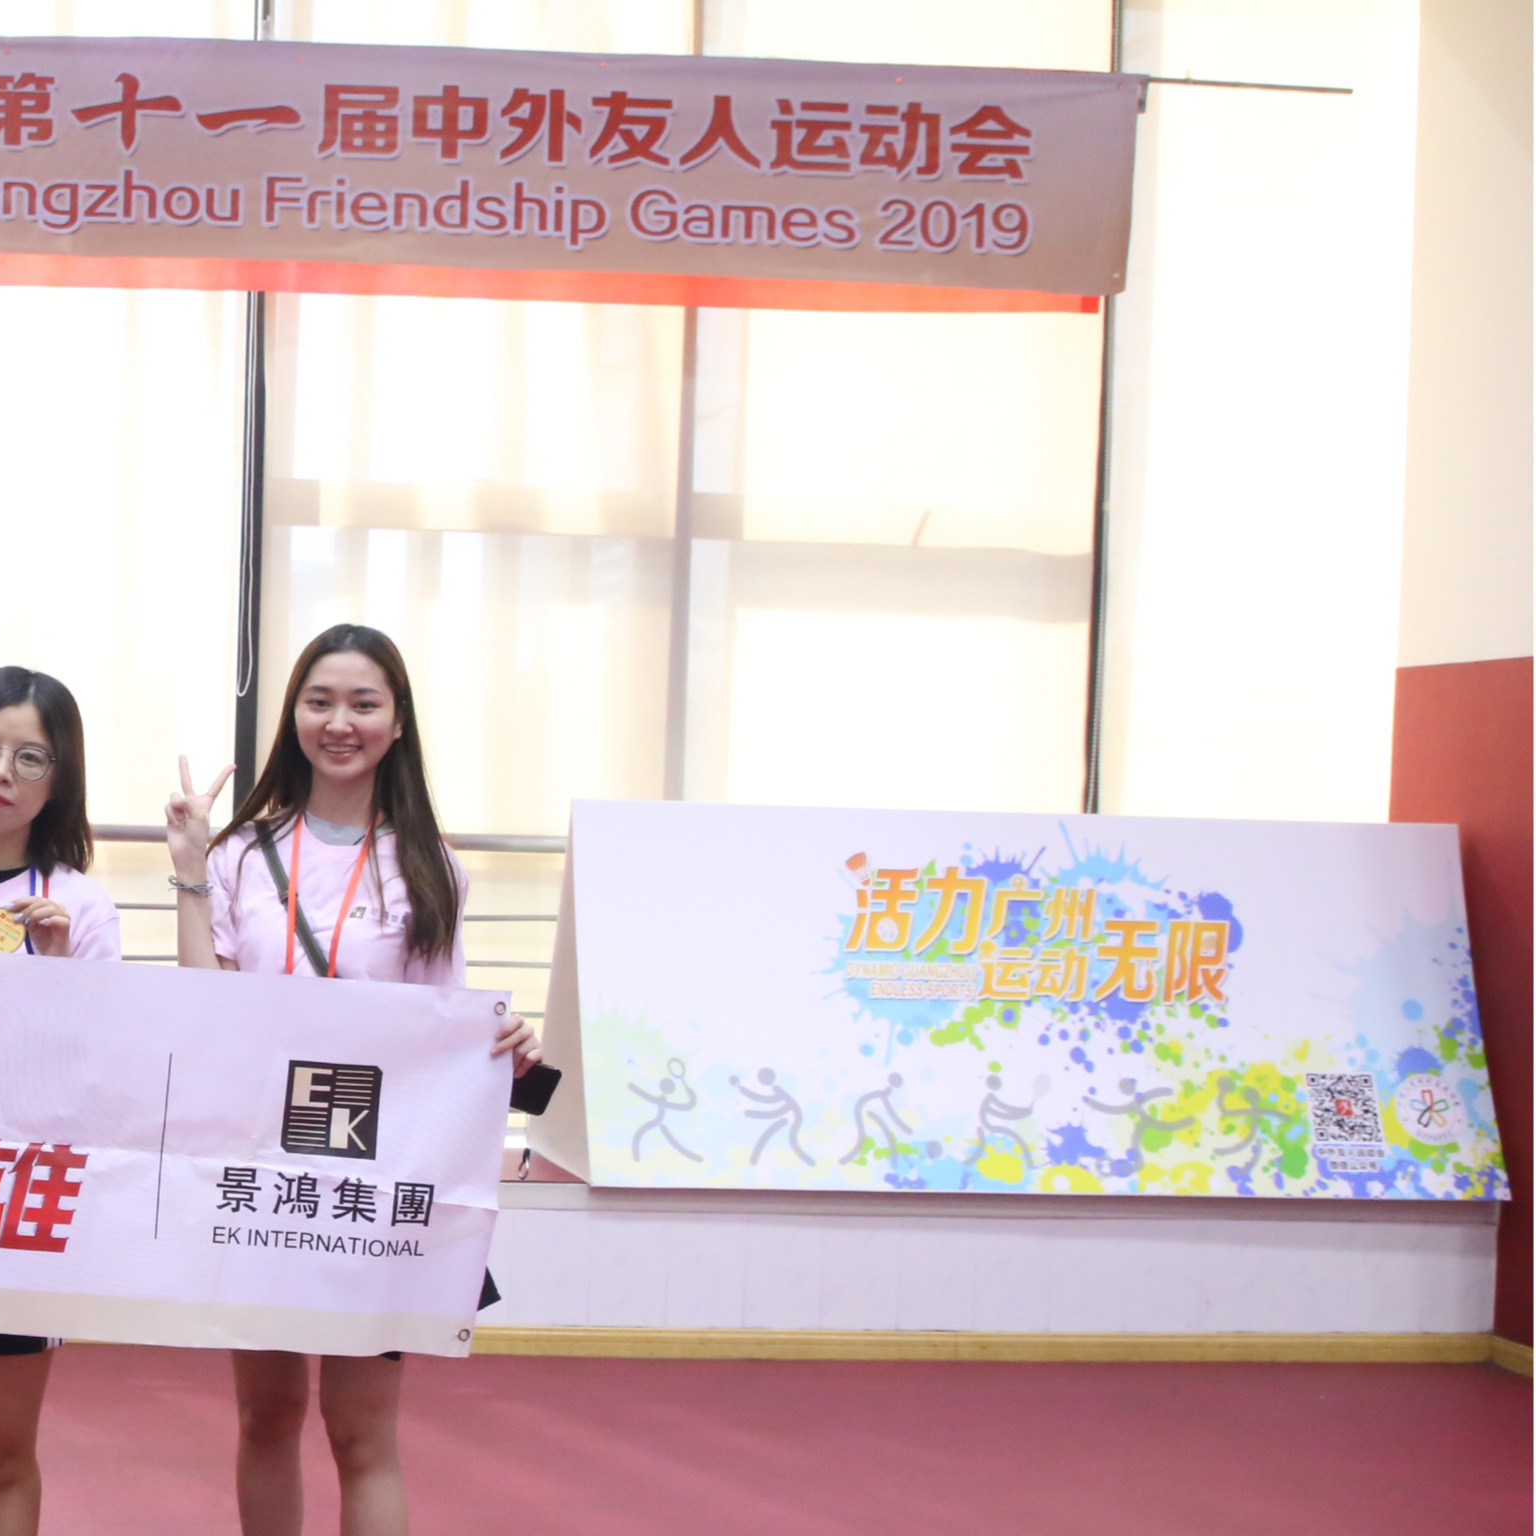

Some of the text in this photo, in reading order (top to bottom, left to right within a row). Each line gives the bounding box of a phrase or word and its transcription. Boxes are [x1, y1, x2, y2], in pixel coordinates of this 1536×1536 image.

[265, 175, 607, 249] Friendship
[631, 188, 859, 246] Games
[878, 199, 1031, 251] 2019
[845, 860, 1096, 956] 活力广州
[978, 918, 1230, 1003] 运动无限
[291, 1065, 370, 1151] EK
[215, 1166, 436, 1228] 景鴻集團
[212, 1226, 425, 1257] EK INTERNATIONAL
